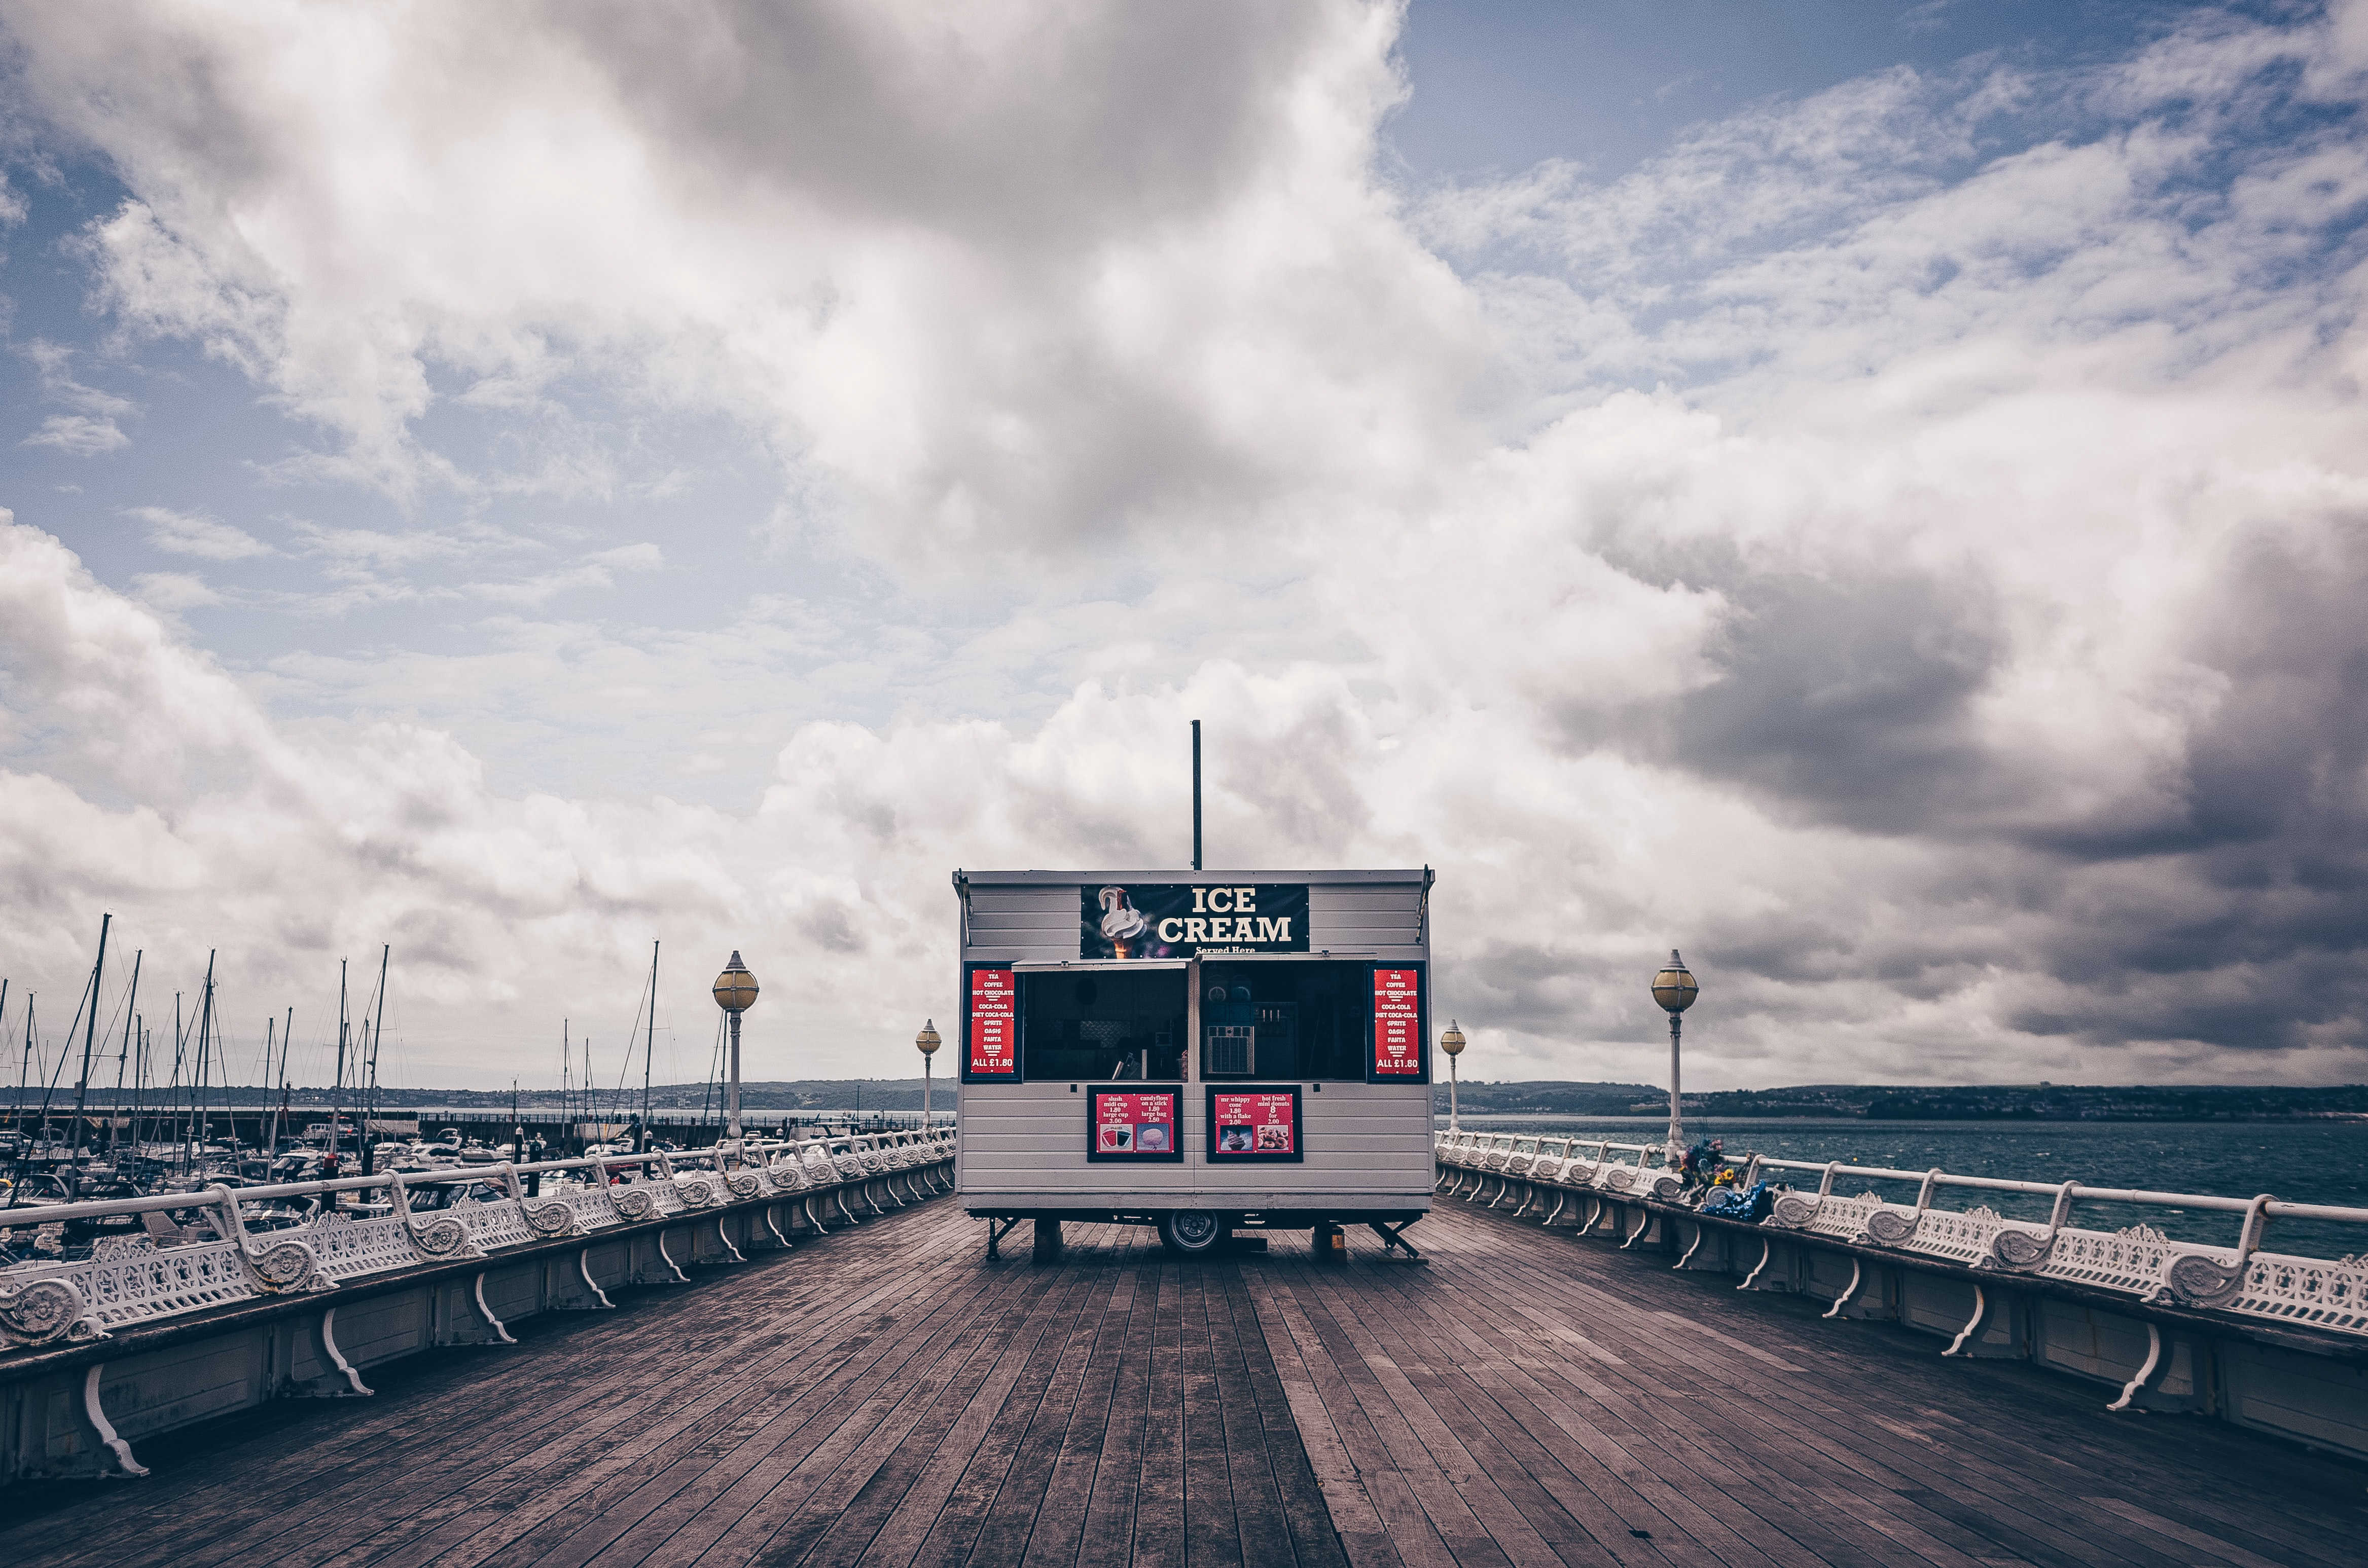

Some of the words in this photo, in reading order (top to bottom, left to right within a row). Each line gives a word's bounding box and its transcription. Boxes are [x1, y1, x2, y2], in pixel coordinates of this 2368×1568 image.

[1192, 888, 1256, 913] ICE
[1158, 917, 1291, 942] CREAM
[972, 1058, 988, 1067] ALL
[989, 1058, 1013, 1067] £1.80
[1377, 1059, 1392, 1068] ALL
[1394, 1059, 1418, 1068] £1.80
